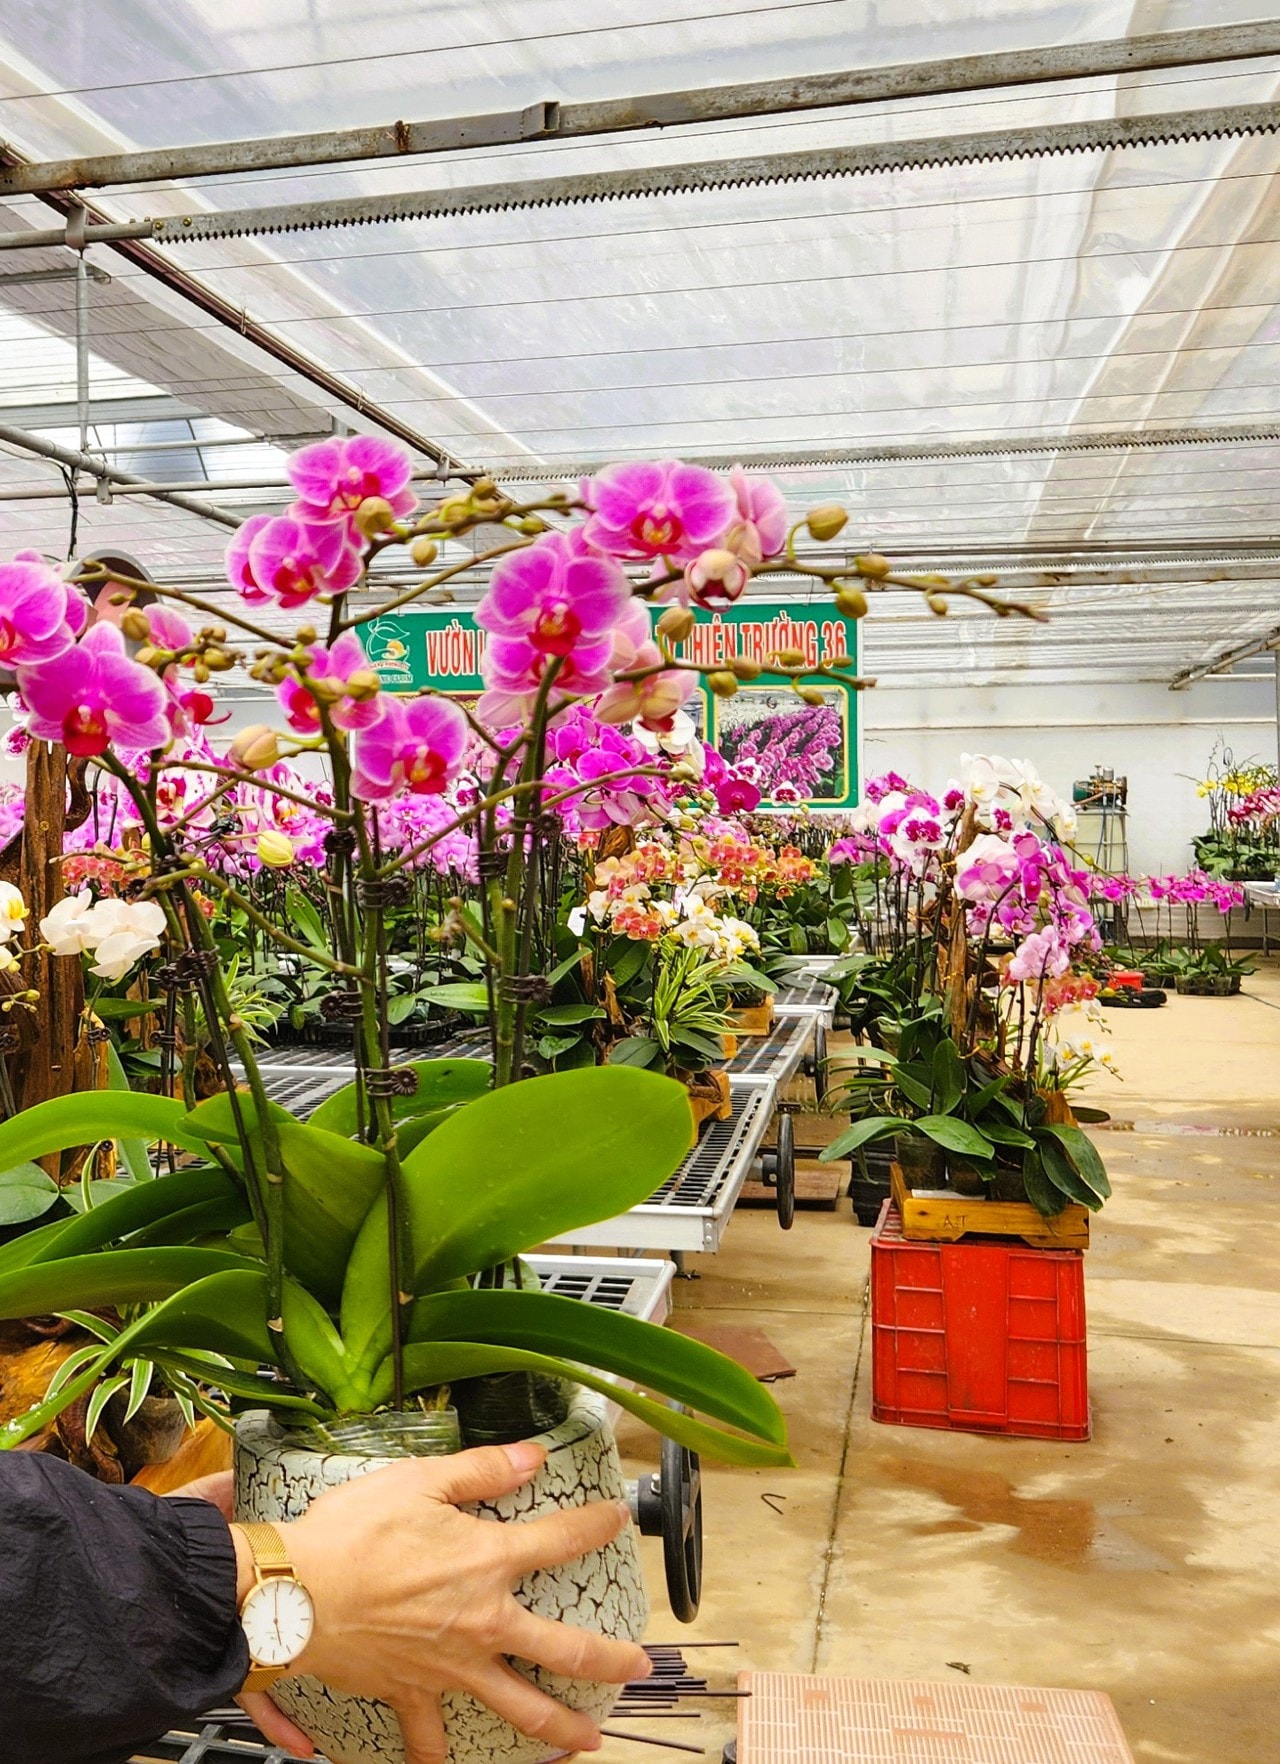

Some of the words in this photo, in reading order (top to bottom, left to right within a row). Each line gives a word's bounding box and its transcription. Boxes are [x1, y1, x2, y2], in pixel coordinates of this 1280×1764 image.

[425, 618, 475, 676] VƯỜN
[739, 610, 819, 669] TRƯỜNG
[821, 620, 847, 669] 36
